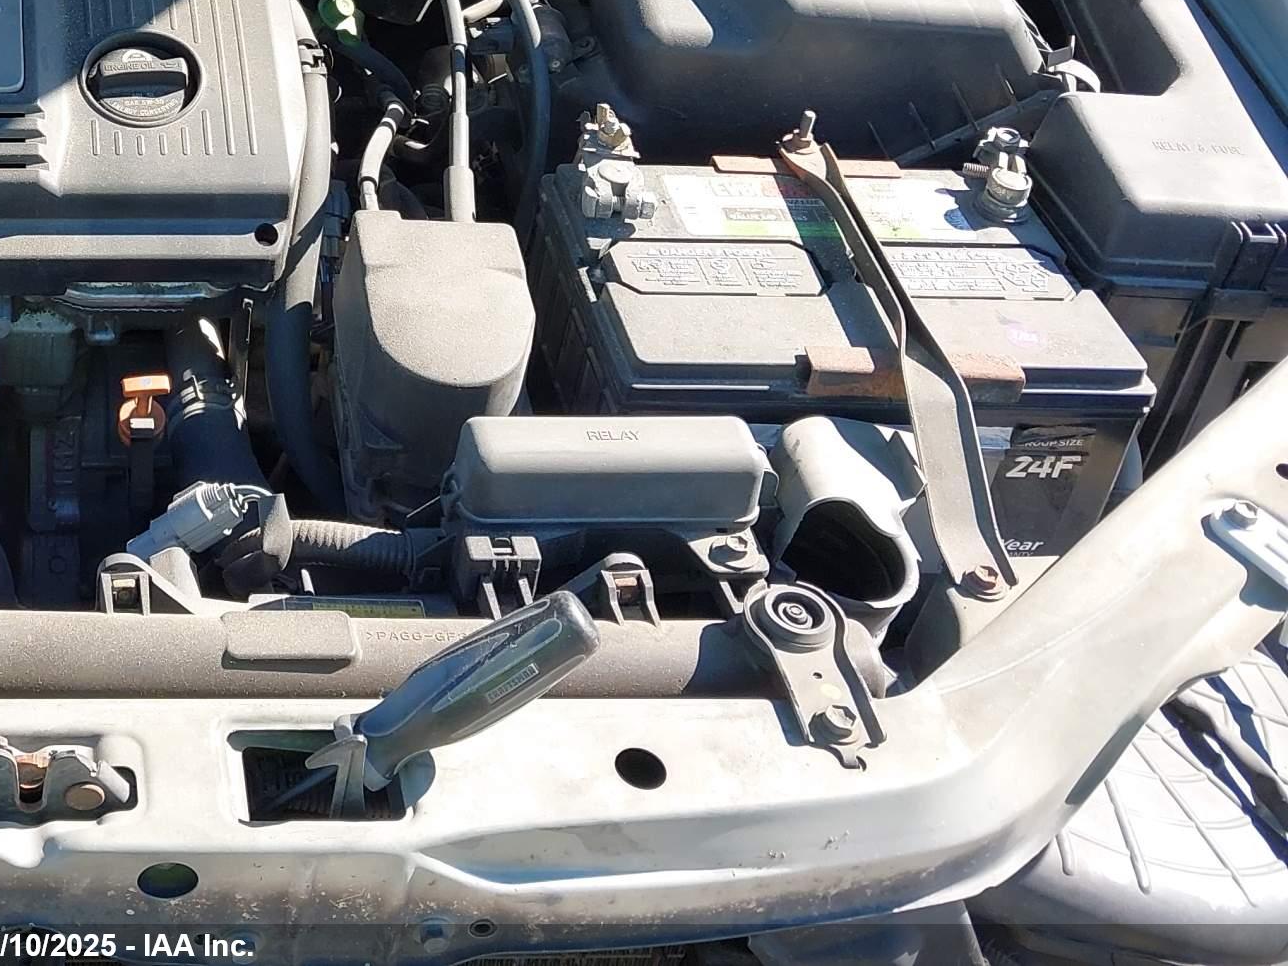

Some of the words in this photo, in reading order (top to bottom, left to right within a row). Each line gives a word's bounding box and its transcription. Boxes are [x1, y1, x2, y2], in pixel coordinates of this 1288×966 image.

[103, 60, 140, 72] ENGINE
[140, 60, 154, 71] OIL
[586, 430, 639, 441] RELAY
[1059, 439, 1084, 447] SIZE
[1005, 455, 1082, 479] 24F
